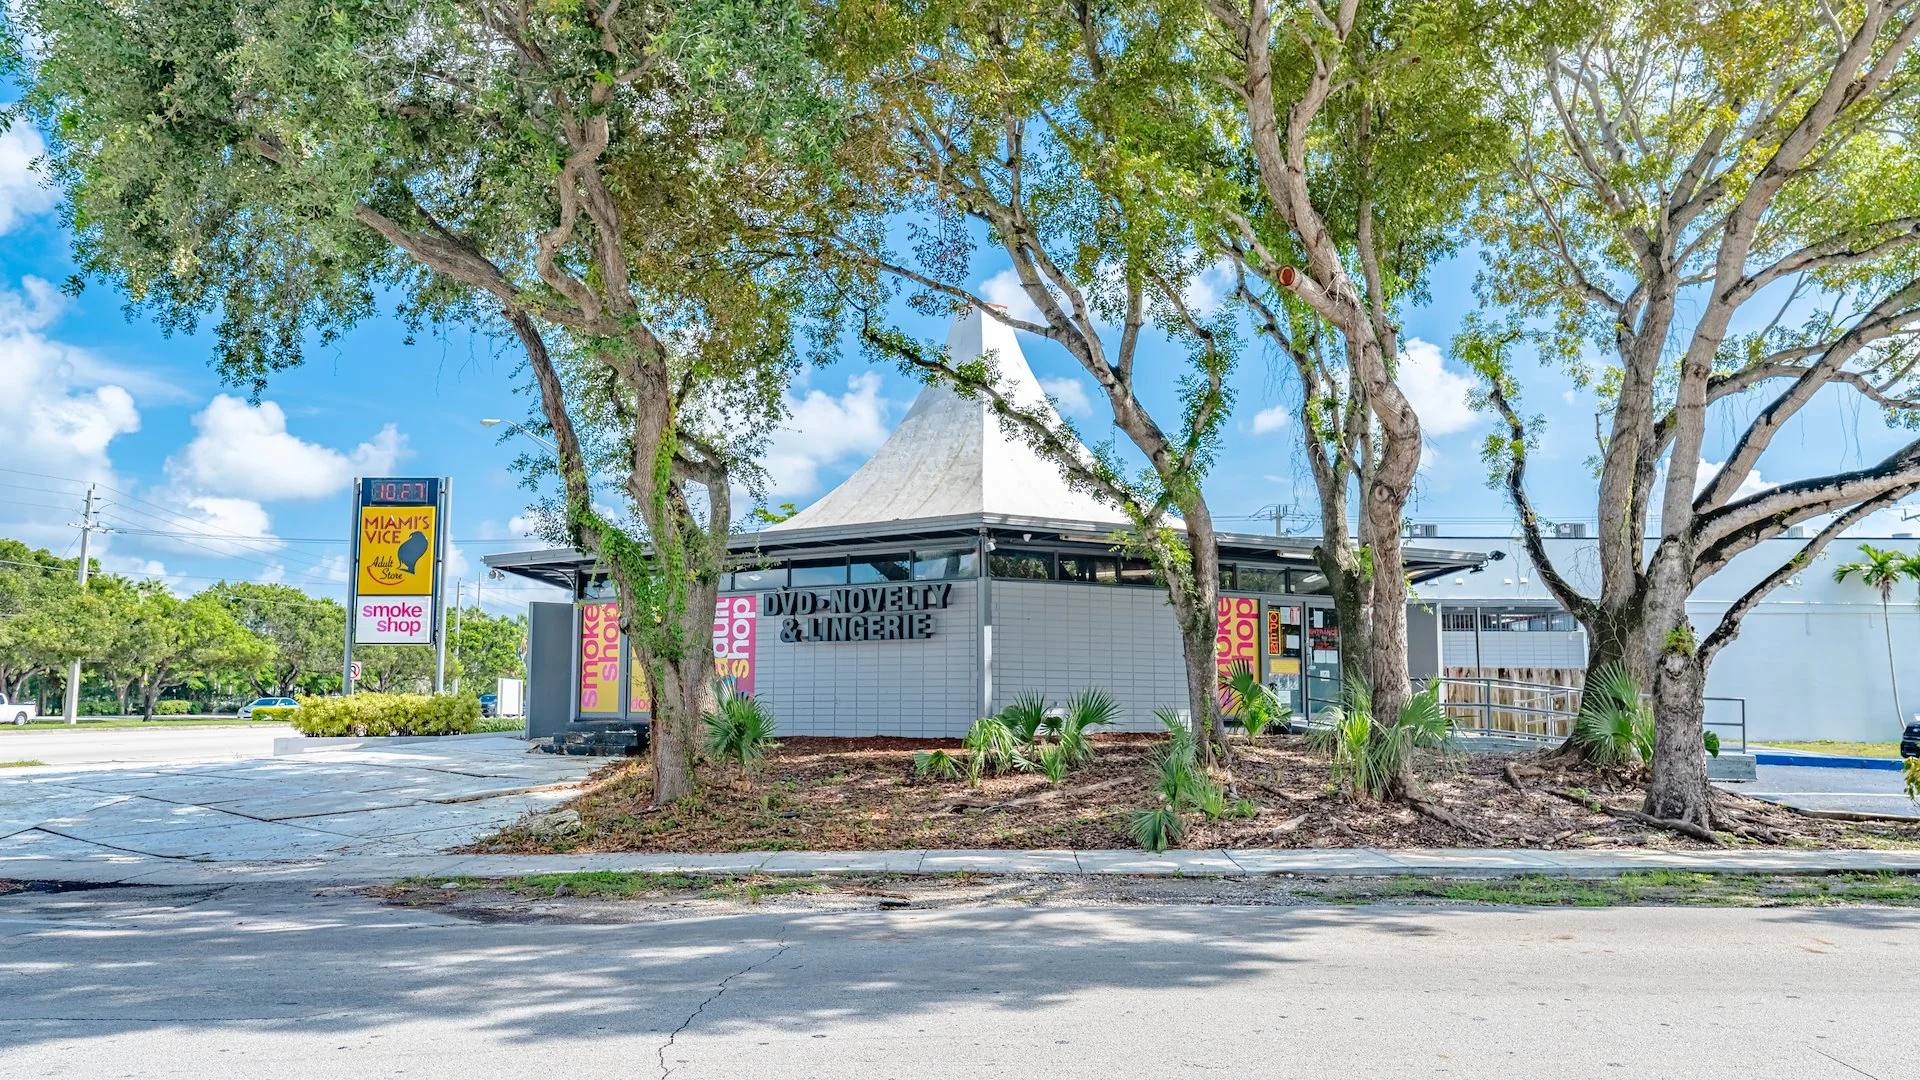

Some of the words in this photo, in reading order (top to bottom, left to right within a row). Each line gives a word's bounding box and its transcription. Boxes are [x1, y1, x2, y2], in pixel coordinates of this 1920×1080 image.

[365, 515, 430, 530] MIAMI'S
[365, 530, 401, 544] VICE
[371, 556, 394, 568] Adult
[379, 568, 403, 580] Store
[362, 602, 423, 618] smoke
[376, 617, 422, 636] shop
[727, 598, 756, 678] shop
[780, 618, 802, 642] &
[808, 614, 931, 642] LINGERIE
[1232, 598, 1258, 676] hop
[1270, 613, 1278, 653] OPEN
[598, 603, 619, 682] shop
[581, 604, 600, 708] smoke
